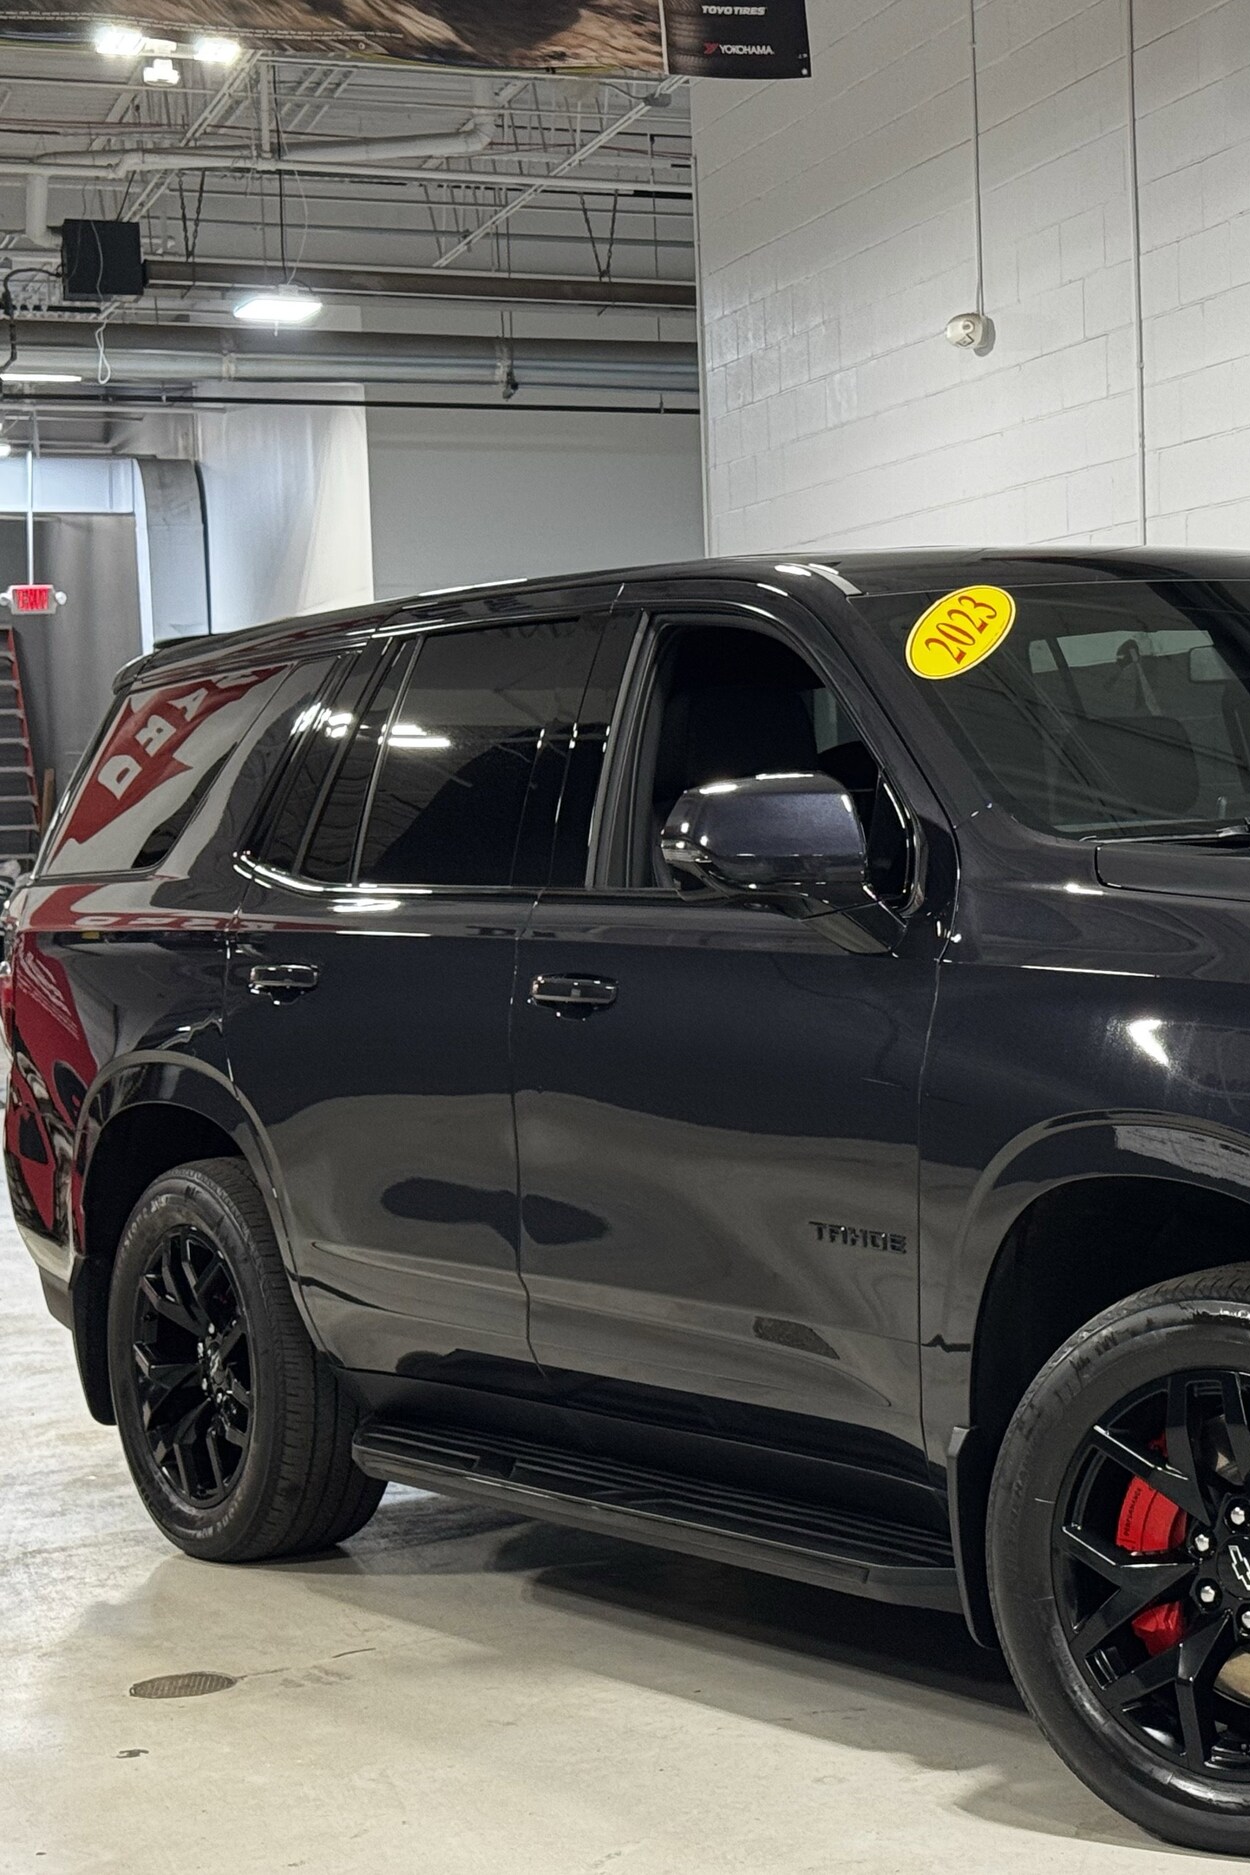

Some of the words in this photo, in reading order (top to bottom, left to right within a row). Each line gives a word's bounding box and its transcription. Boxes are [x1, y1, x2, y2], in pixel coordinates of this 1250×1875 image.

[701, 5, 733, 15] TOYO
[733, 6, 767, 16] TIRES
[719, 44, 775, 55] YOKOHAMA
[924, 595, 997, 665] 2023
[808, 1221, 907, 1254] TAHOE
